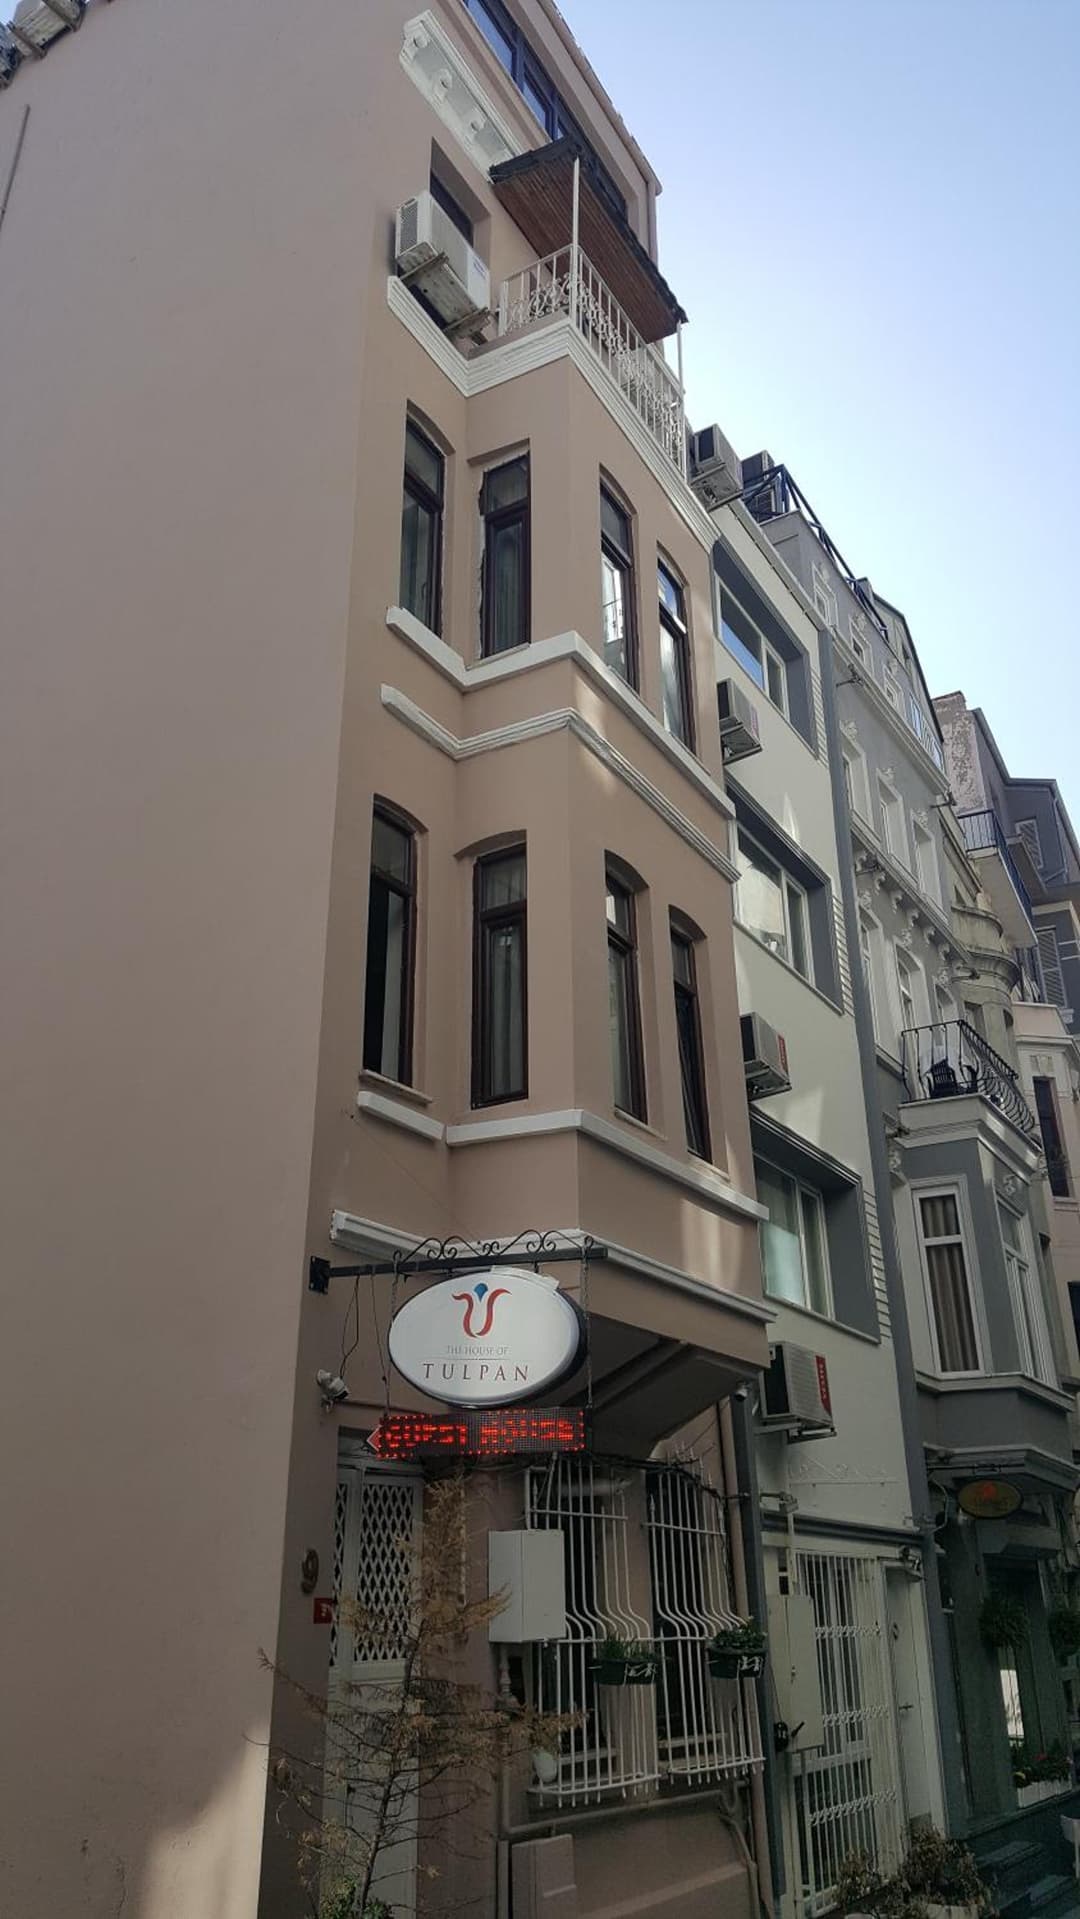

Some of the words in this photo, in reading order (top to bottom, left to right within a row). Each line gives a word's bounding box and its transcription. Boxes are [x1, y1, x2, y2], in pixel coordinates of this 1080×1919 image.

[447, 1345, 461, 1355] THE
[464, 1345, 493, 1355] HOUSE
[497, 1346, 509, 1355] OF
[423, 1363, 529, 1381] TULPAN
[301, 1549, 319, 1595] 9
